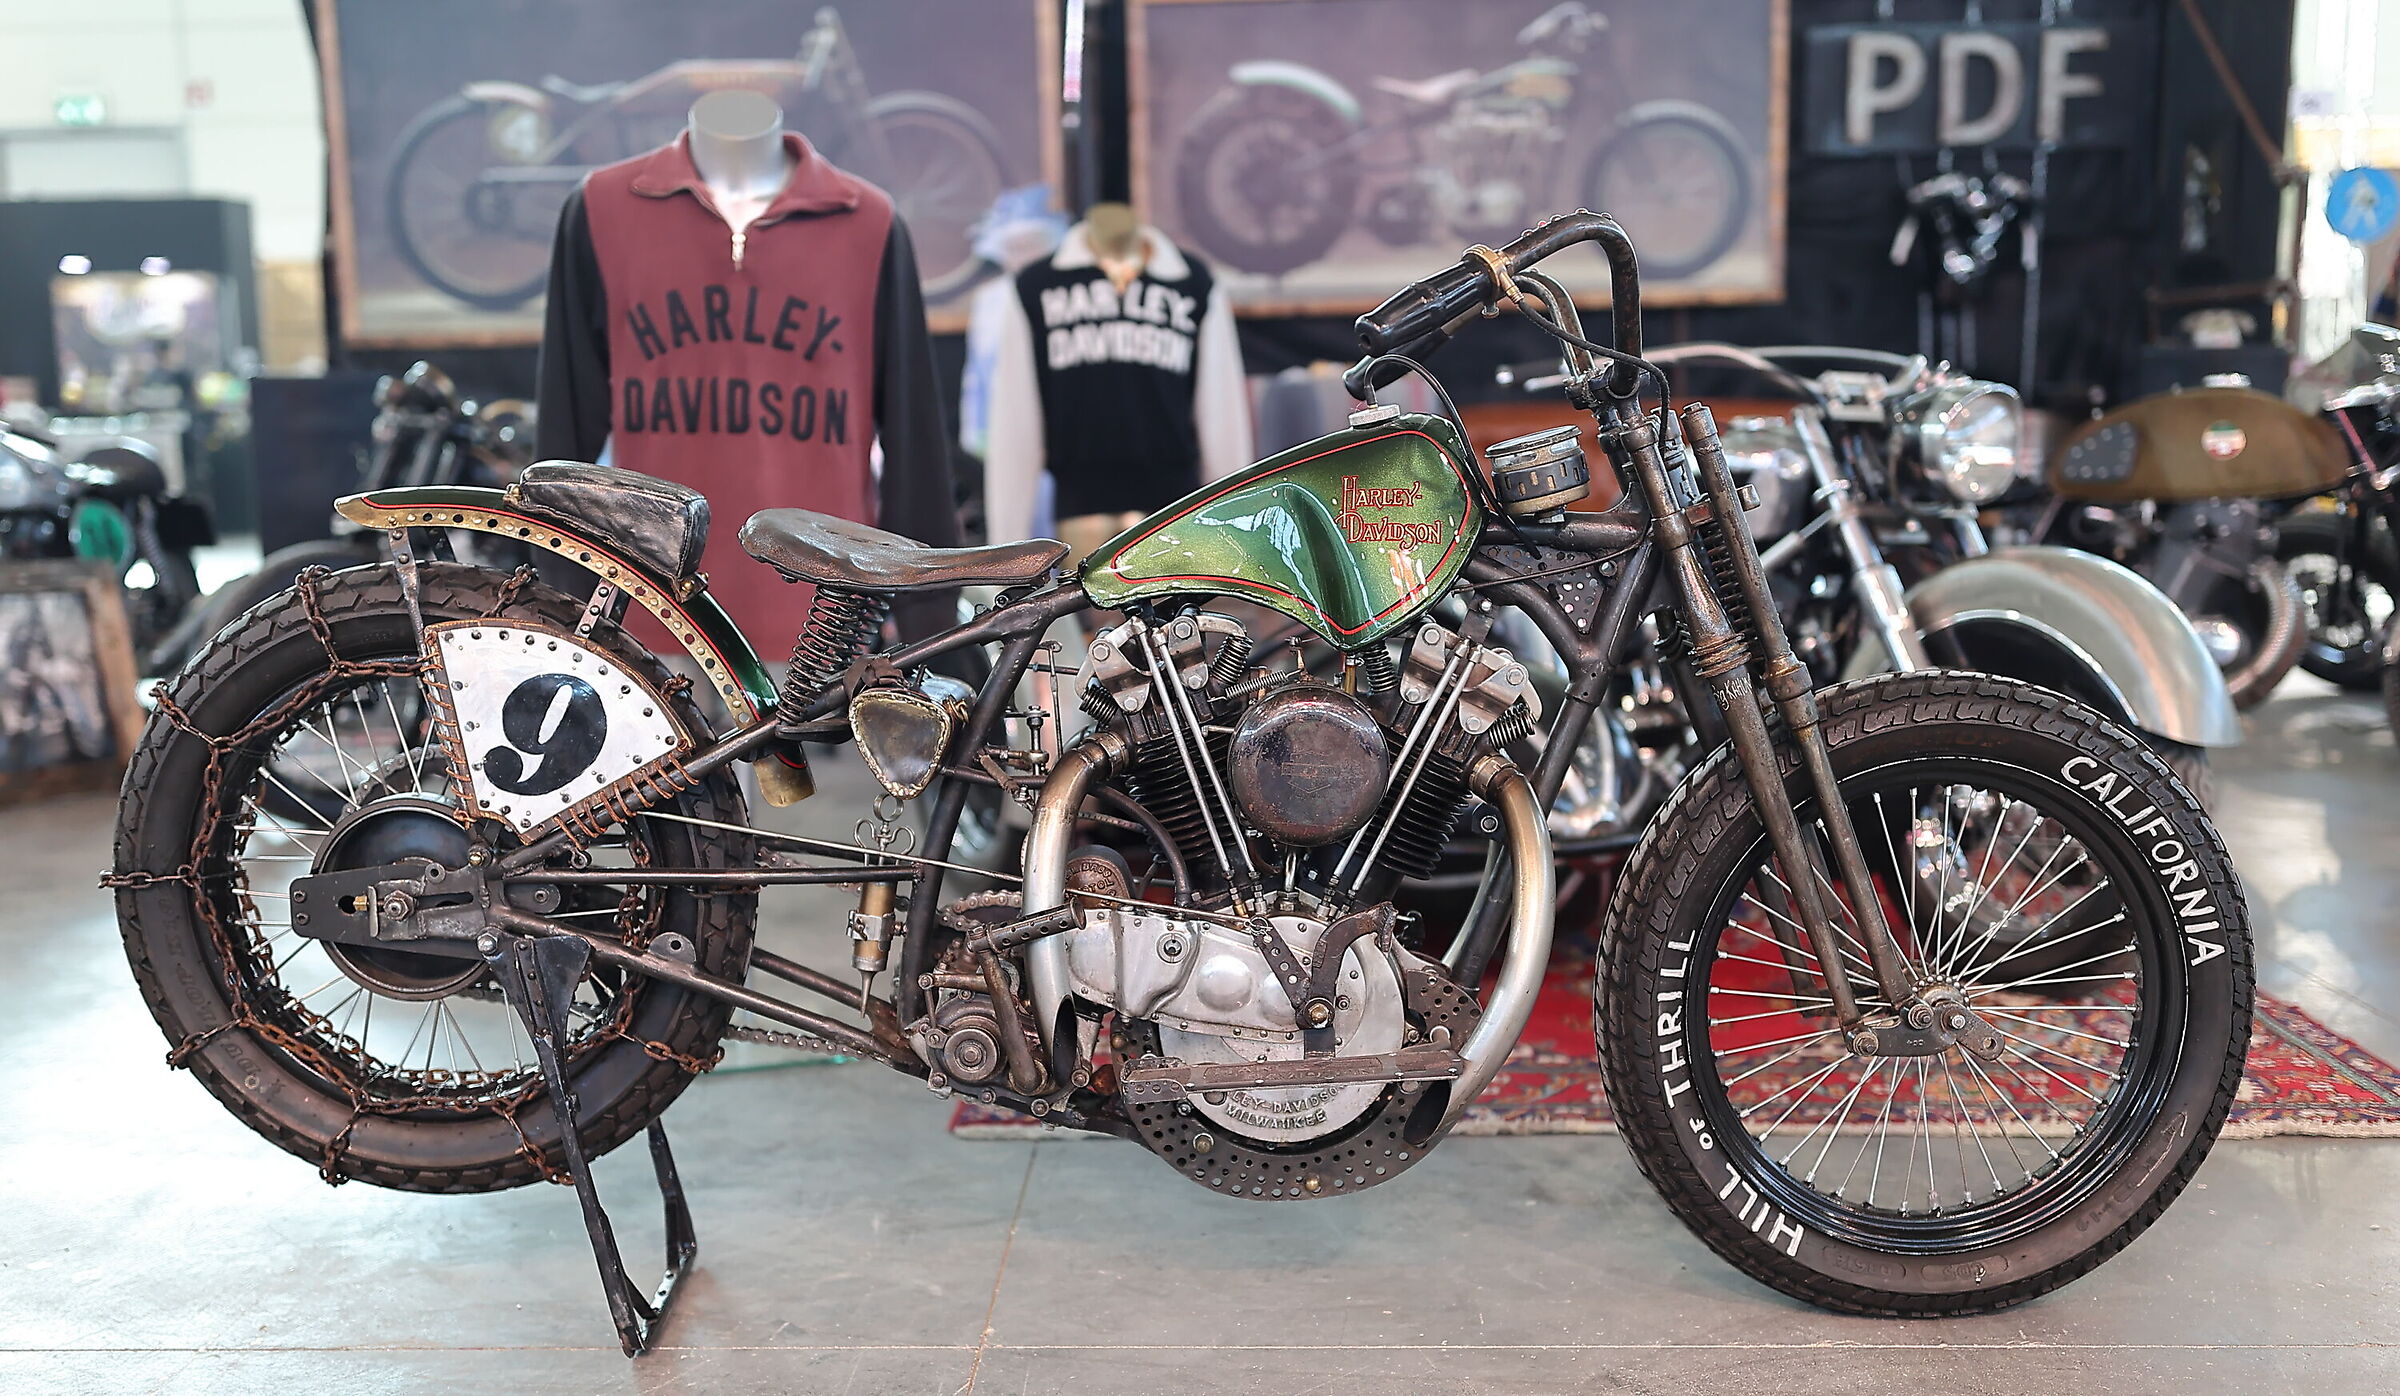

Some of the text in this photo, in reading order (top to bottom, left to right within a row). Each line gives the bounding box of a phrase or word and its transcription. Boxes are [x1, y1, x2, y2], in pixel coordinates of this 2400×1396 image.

[1845, 29, 2109, 145] PDF
[626, 284, 844, 361] HARLEY-
[1047, 320, 1194, 374] DAVIDSON
[623, 377, 848, 445] DAVIDSON
[484, 673, 607, 796] 9
[2061, 756, 2226, 967] CALIFORNIA
[1657, 930, 1696, 1109] THRILL
[1226, 1103, 1328, 1129] MILWAUKEE
[1228, 1085, 1345, 1114] LEY-DAVIDSO
[1719, 1162, 1804, 1257] HILL
